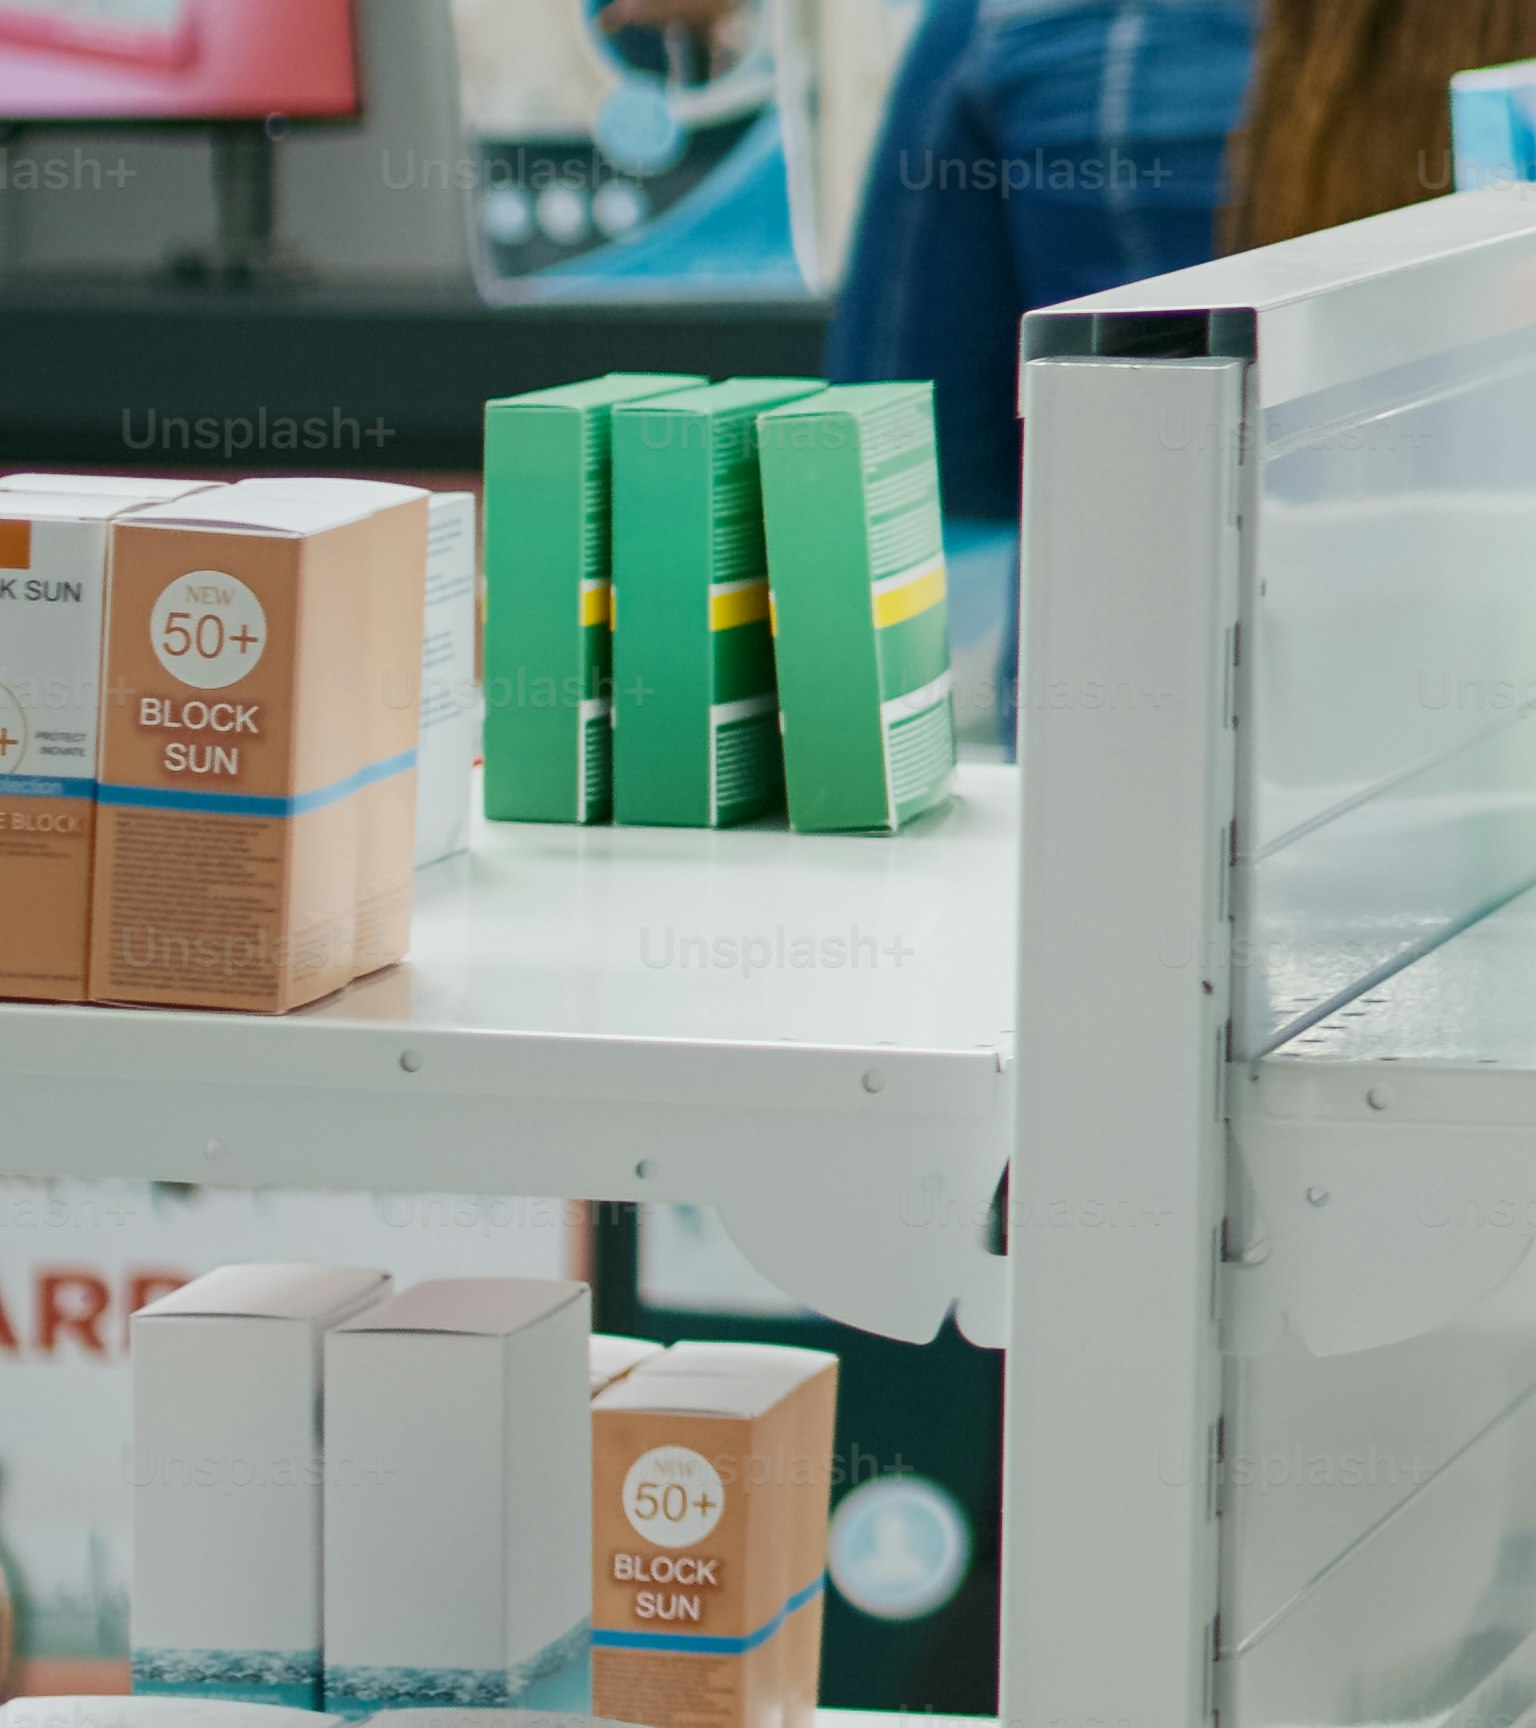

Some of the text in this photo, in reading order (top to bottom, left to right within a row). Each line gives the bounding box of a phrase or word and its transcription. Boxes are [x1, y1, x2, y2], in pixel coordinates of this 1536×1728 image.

[24, 580, 82, 602] SUN
[184, 585, 236, 606] NEW
[162, 612, 259, 659] 50+
[140, 698, 260, 733] BLOCK
[163, 742, 240, 775] SUN
[12, 812, 82, 833] BLOCK
[633, 1481, 717, 1522] 50+
[613, 1553, 718, 1586] BLOCK
[635, 1591, 701, 1621] SUN
